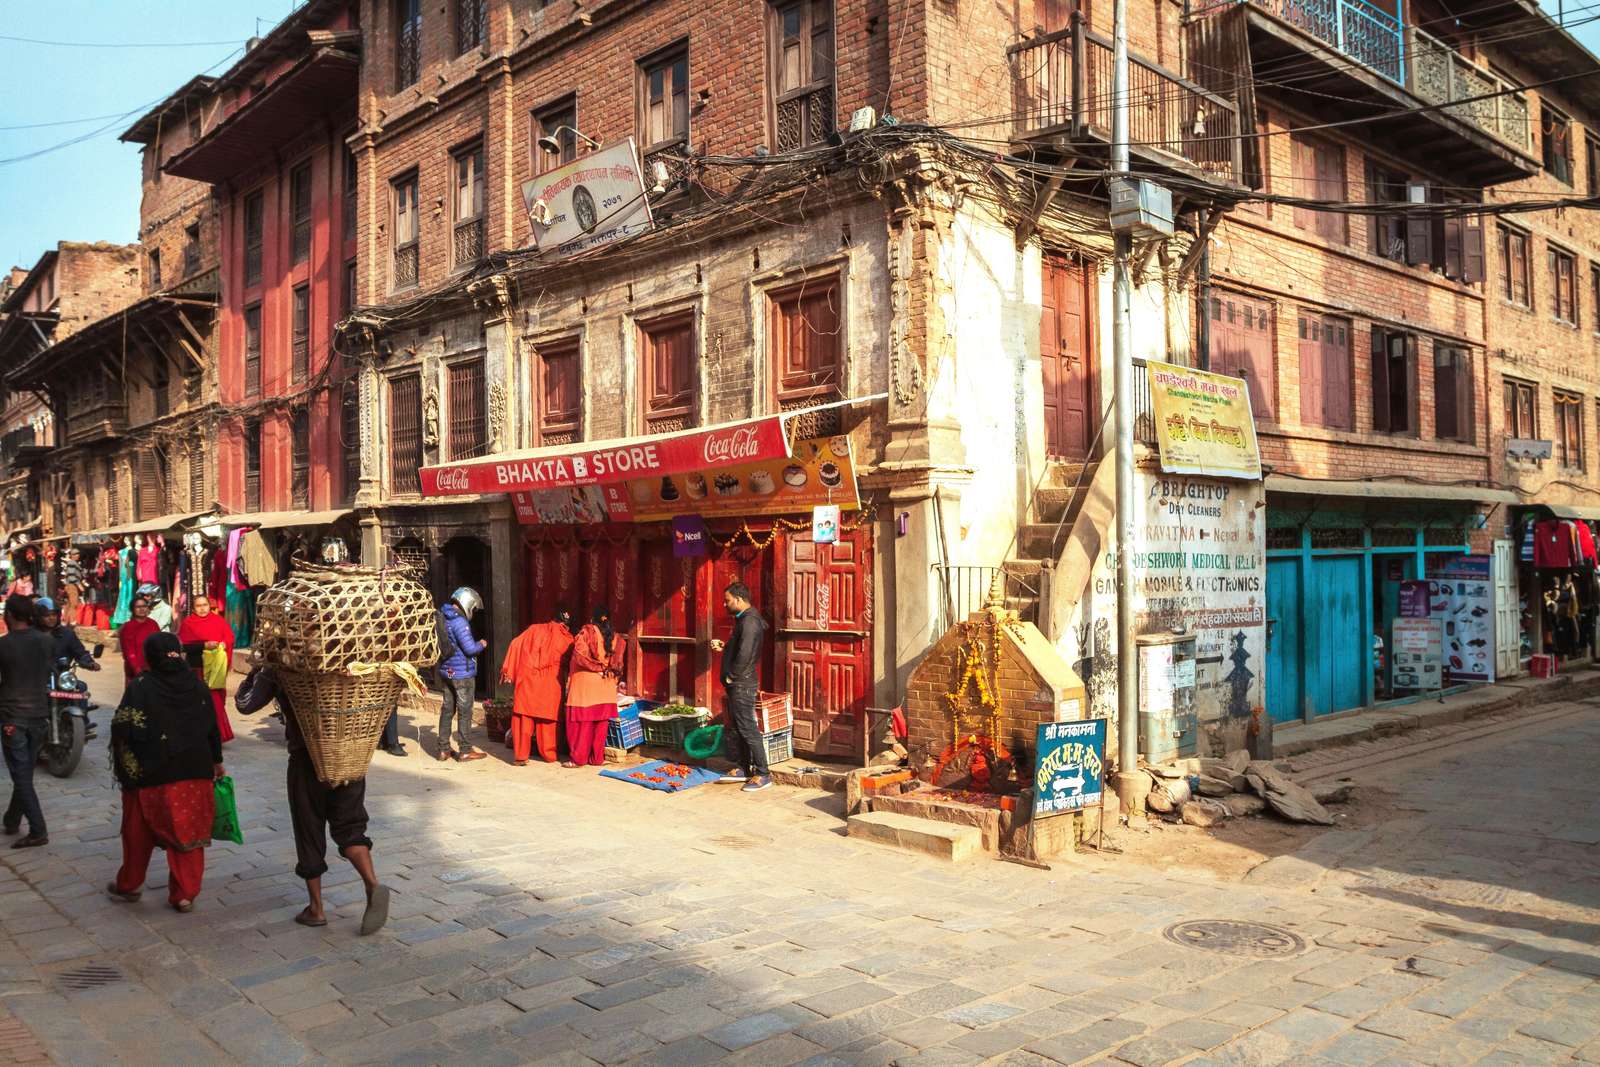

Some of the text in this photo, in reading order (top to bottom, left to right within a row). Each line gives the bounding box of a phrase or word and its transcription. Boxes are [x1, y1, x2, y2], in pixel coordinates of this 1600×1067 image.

[704, 426, 759, 462] Coca-Cola
[496, 445, 660, 485] BHAKTA B STORE
[436, 467, 469, 491] Coca-Cola
[1162, 481, 1229, 500] BRIGHTOP
[1169, 502, 1221, 518] DRY CLEANERS
[684, 531, 701, 541] Ncell
[1192, 552, 1231, 570] MEDICAL
